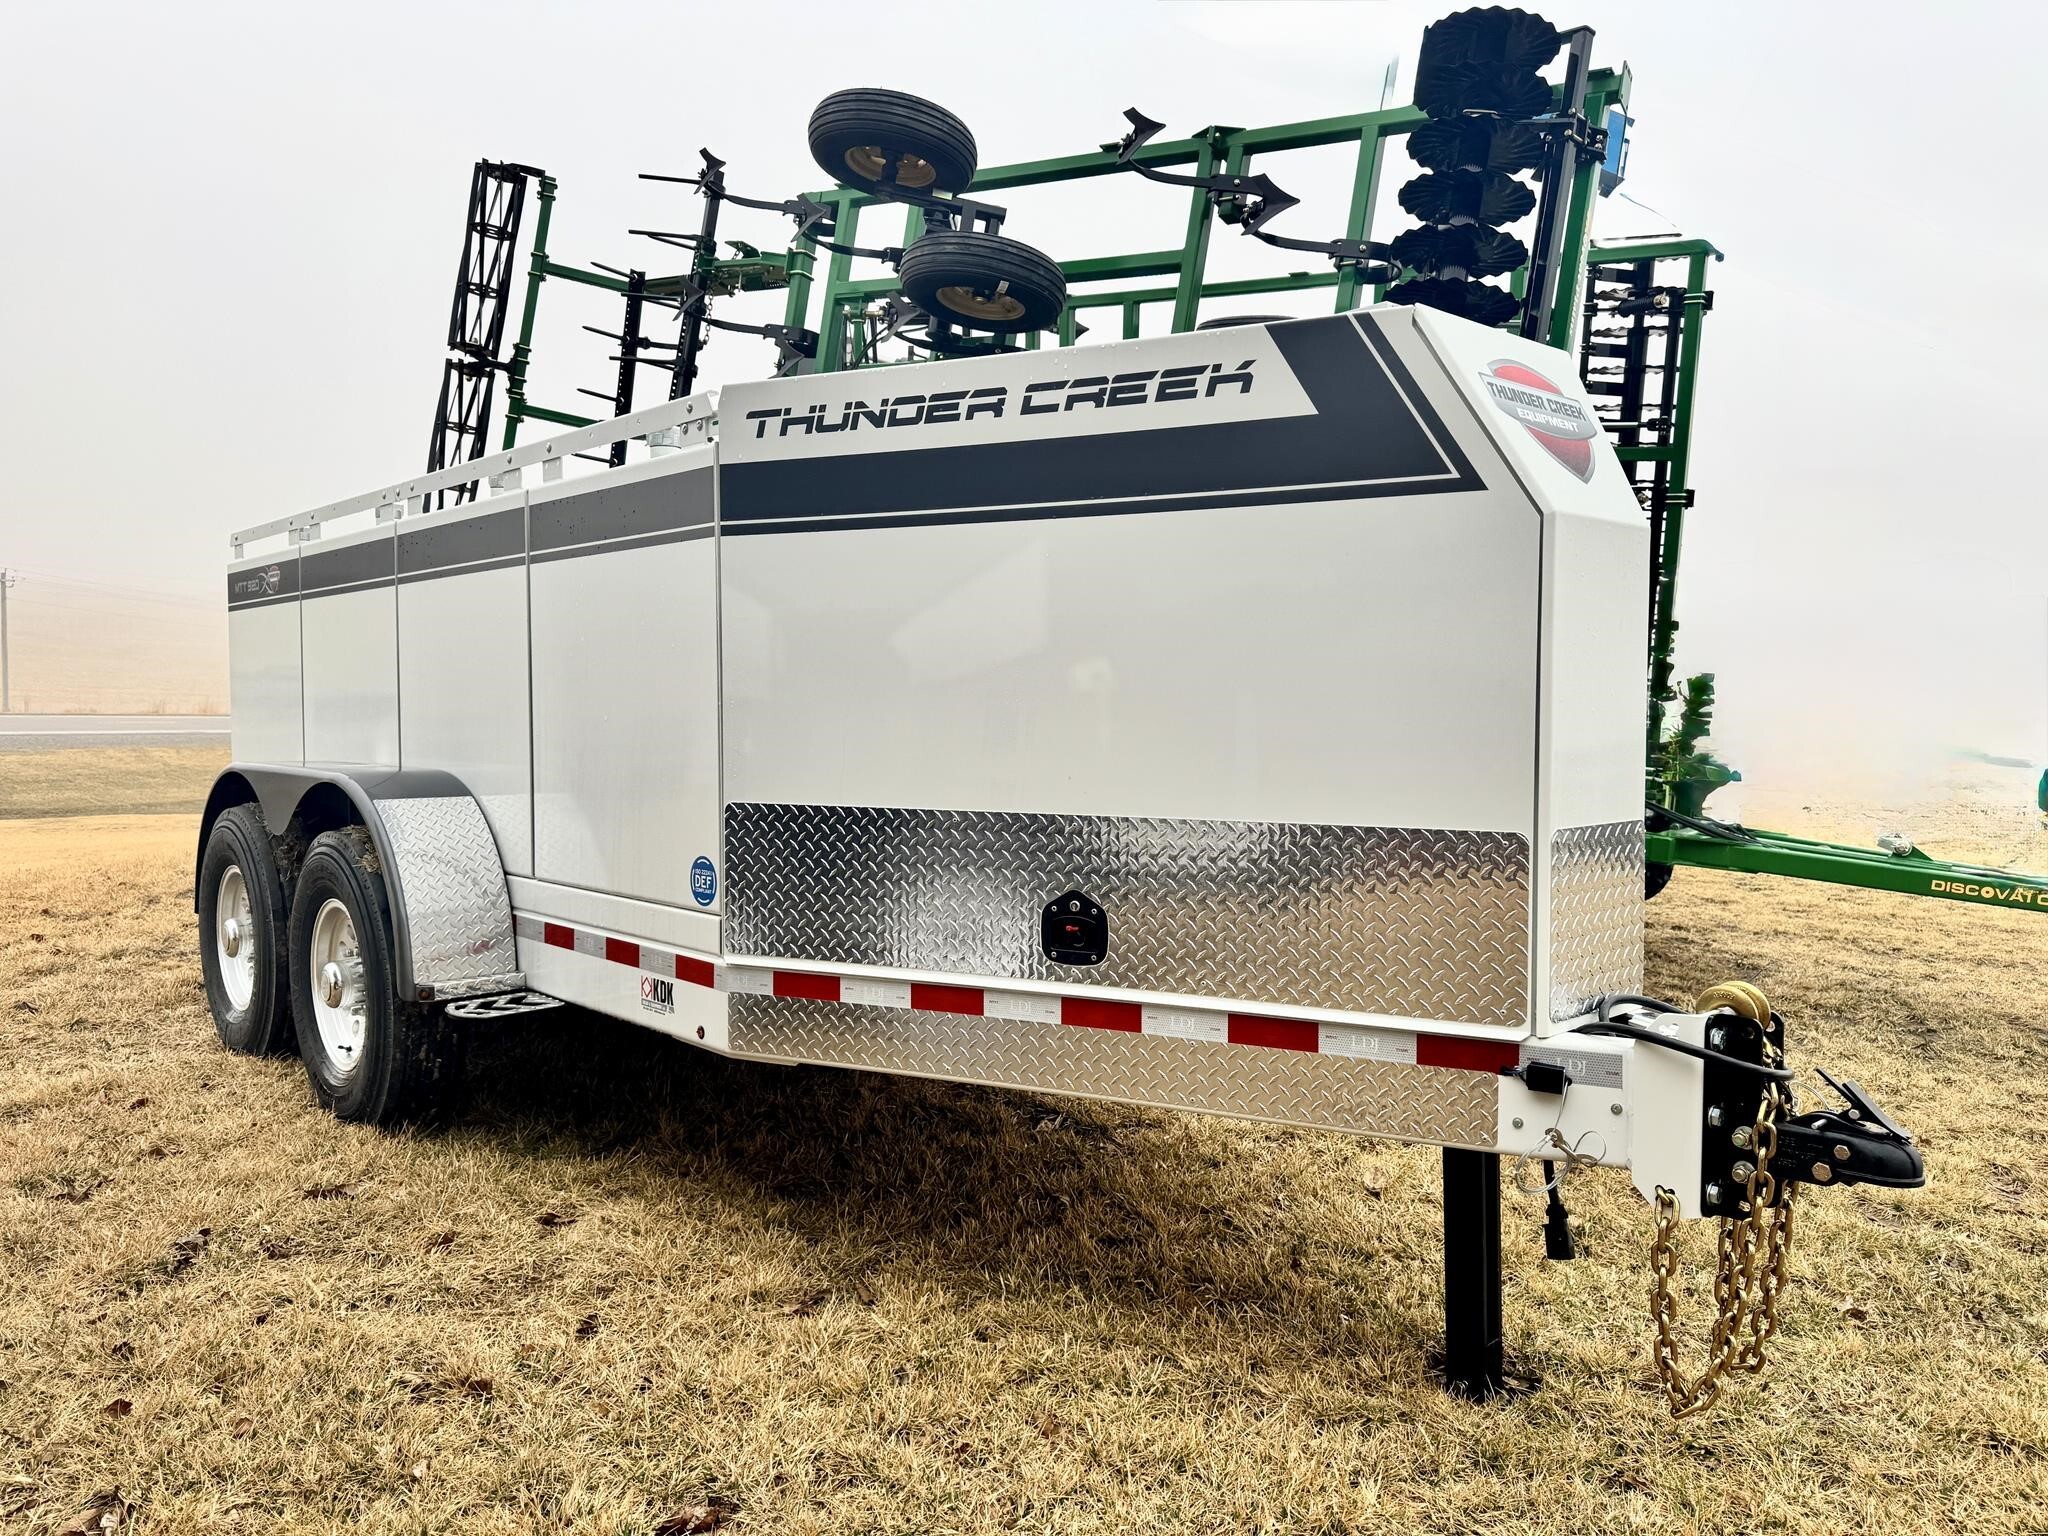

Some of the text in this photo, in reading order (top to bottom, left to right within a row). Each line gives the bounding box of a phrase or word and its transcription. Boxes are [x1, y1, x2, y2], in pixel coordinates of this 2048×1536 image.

[745, 358, 1258, 439] THUNDER CREEK
[1486, 381, 1587, 422] THUNDER CREEK
[1515, 407, 1580, 433] EQUIPMENT
[695, 874, 712, 889] DEF
[653, 977, 674, 1007] KDK
